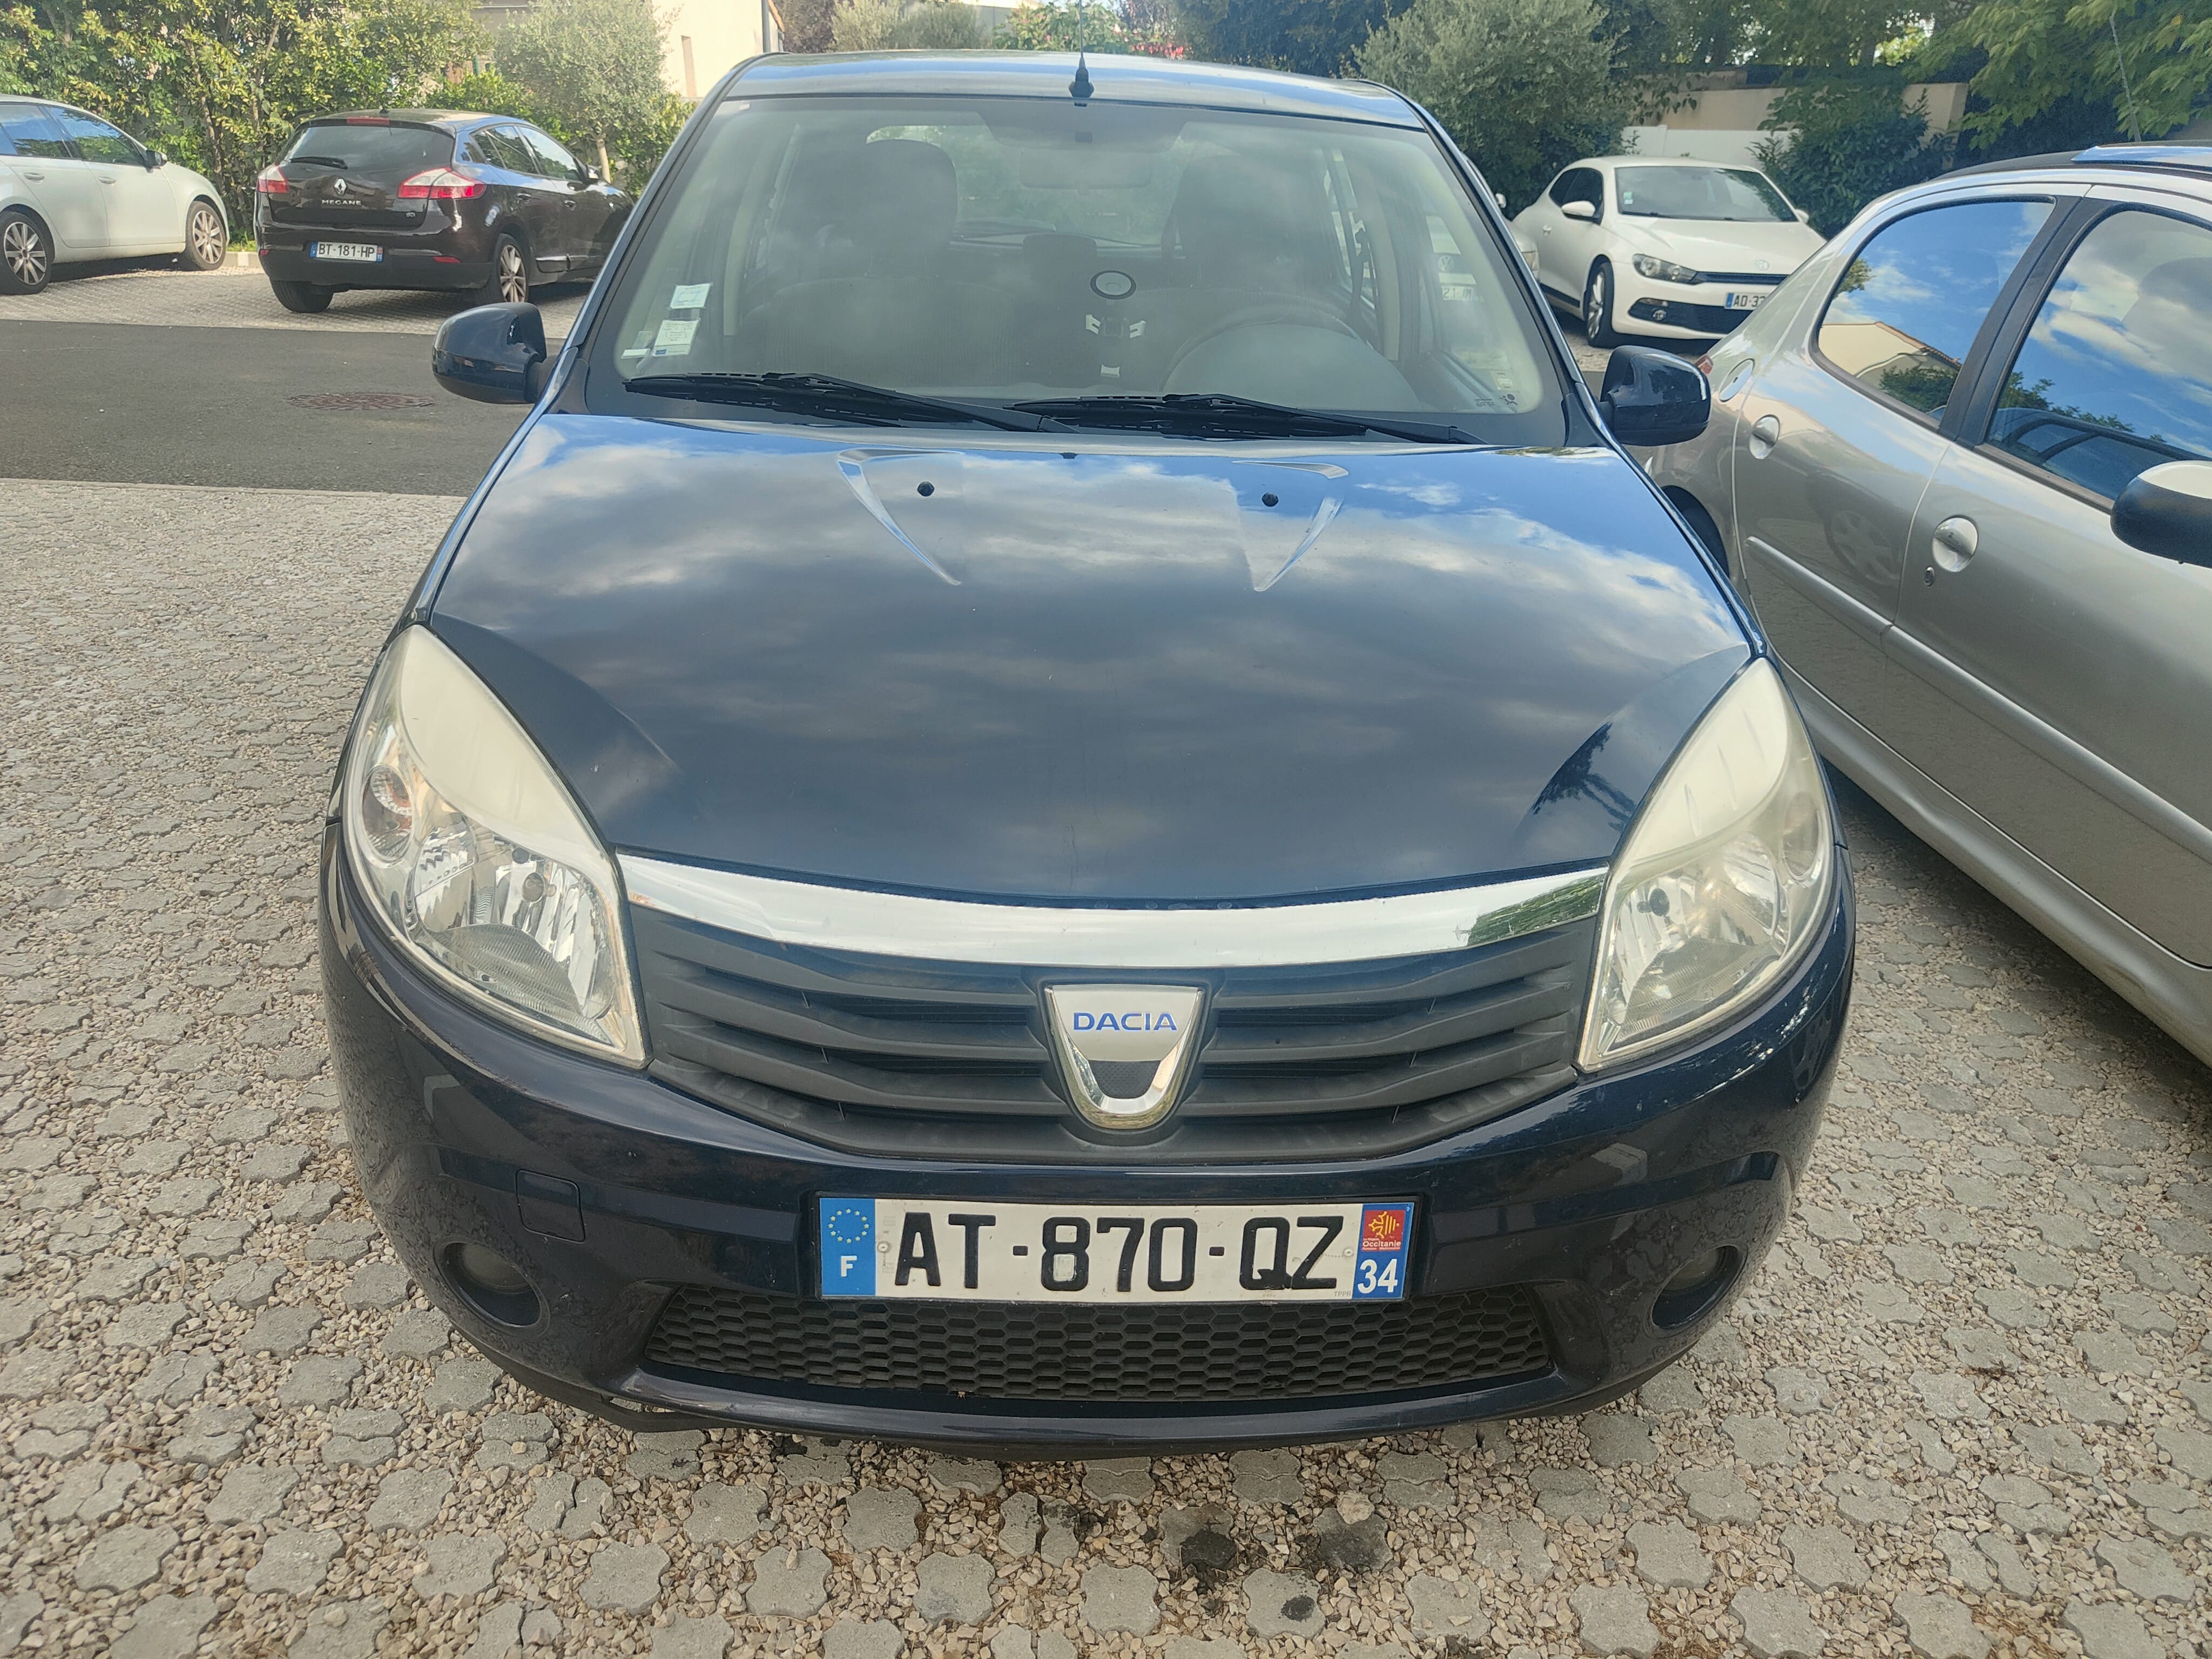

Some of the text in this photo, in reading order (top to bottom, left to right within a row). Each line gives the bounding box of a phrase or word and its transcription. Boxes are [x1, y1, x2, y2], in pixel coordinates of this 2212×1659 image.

[319, 244, 375, 258] BT-181-HP
[1074, 1013, 1177, 1030] DACIA
[894, 1212, 1344, 1291] AT-870-QZ
[1363, 1239, 1401, 1247] Occitanie
[840, 1255, 858, 1277] F
[1357, 1258, 1398, 1294] 34
